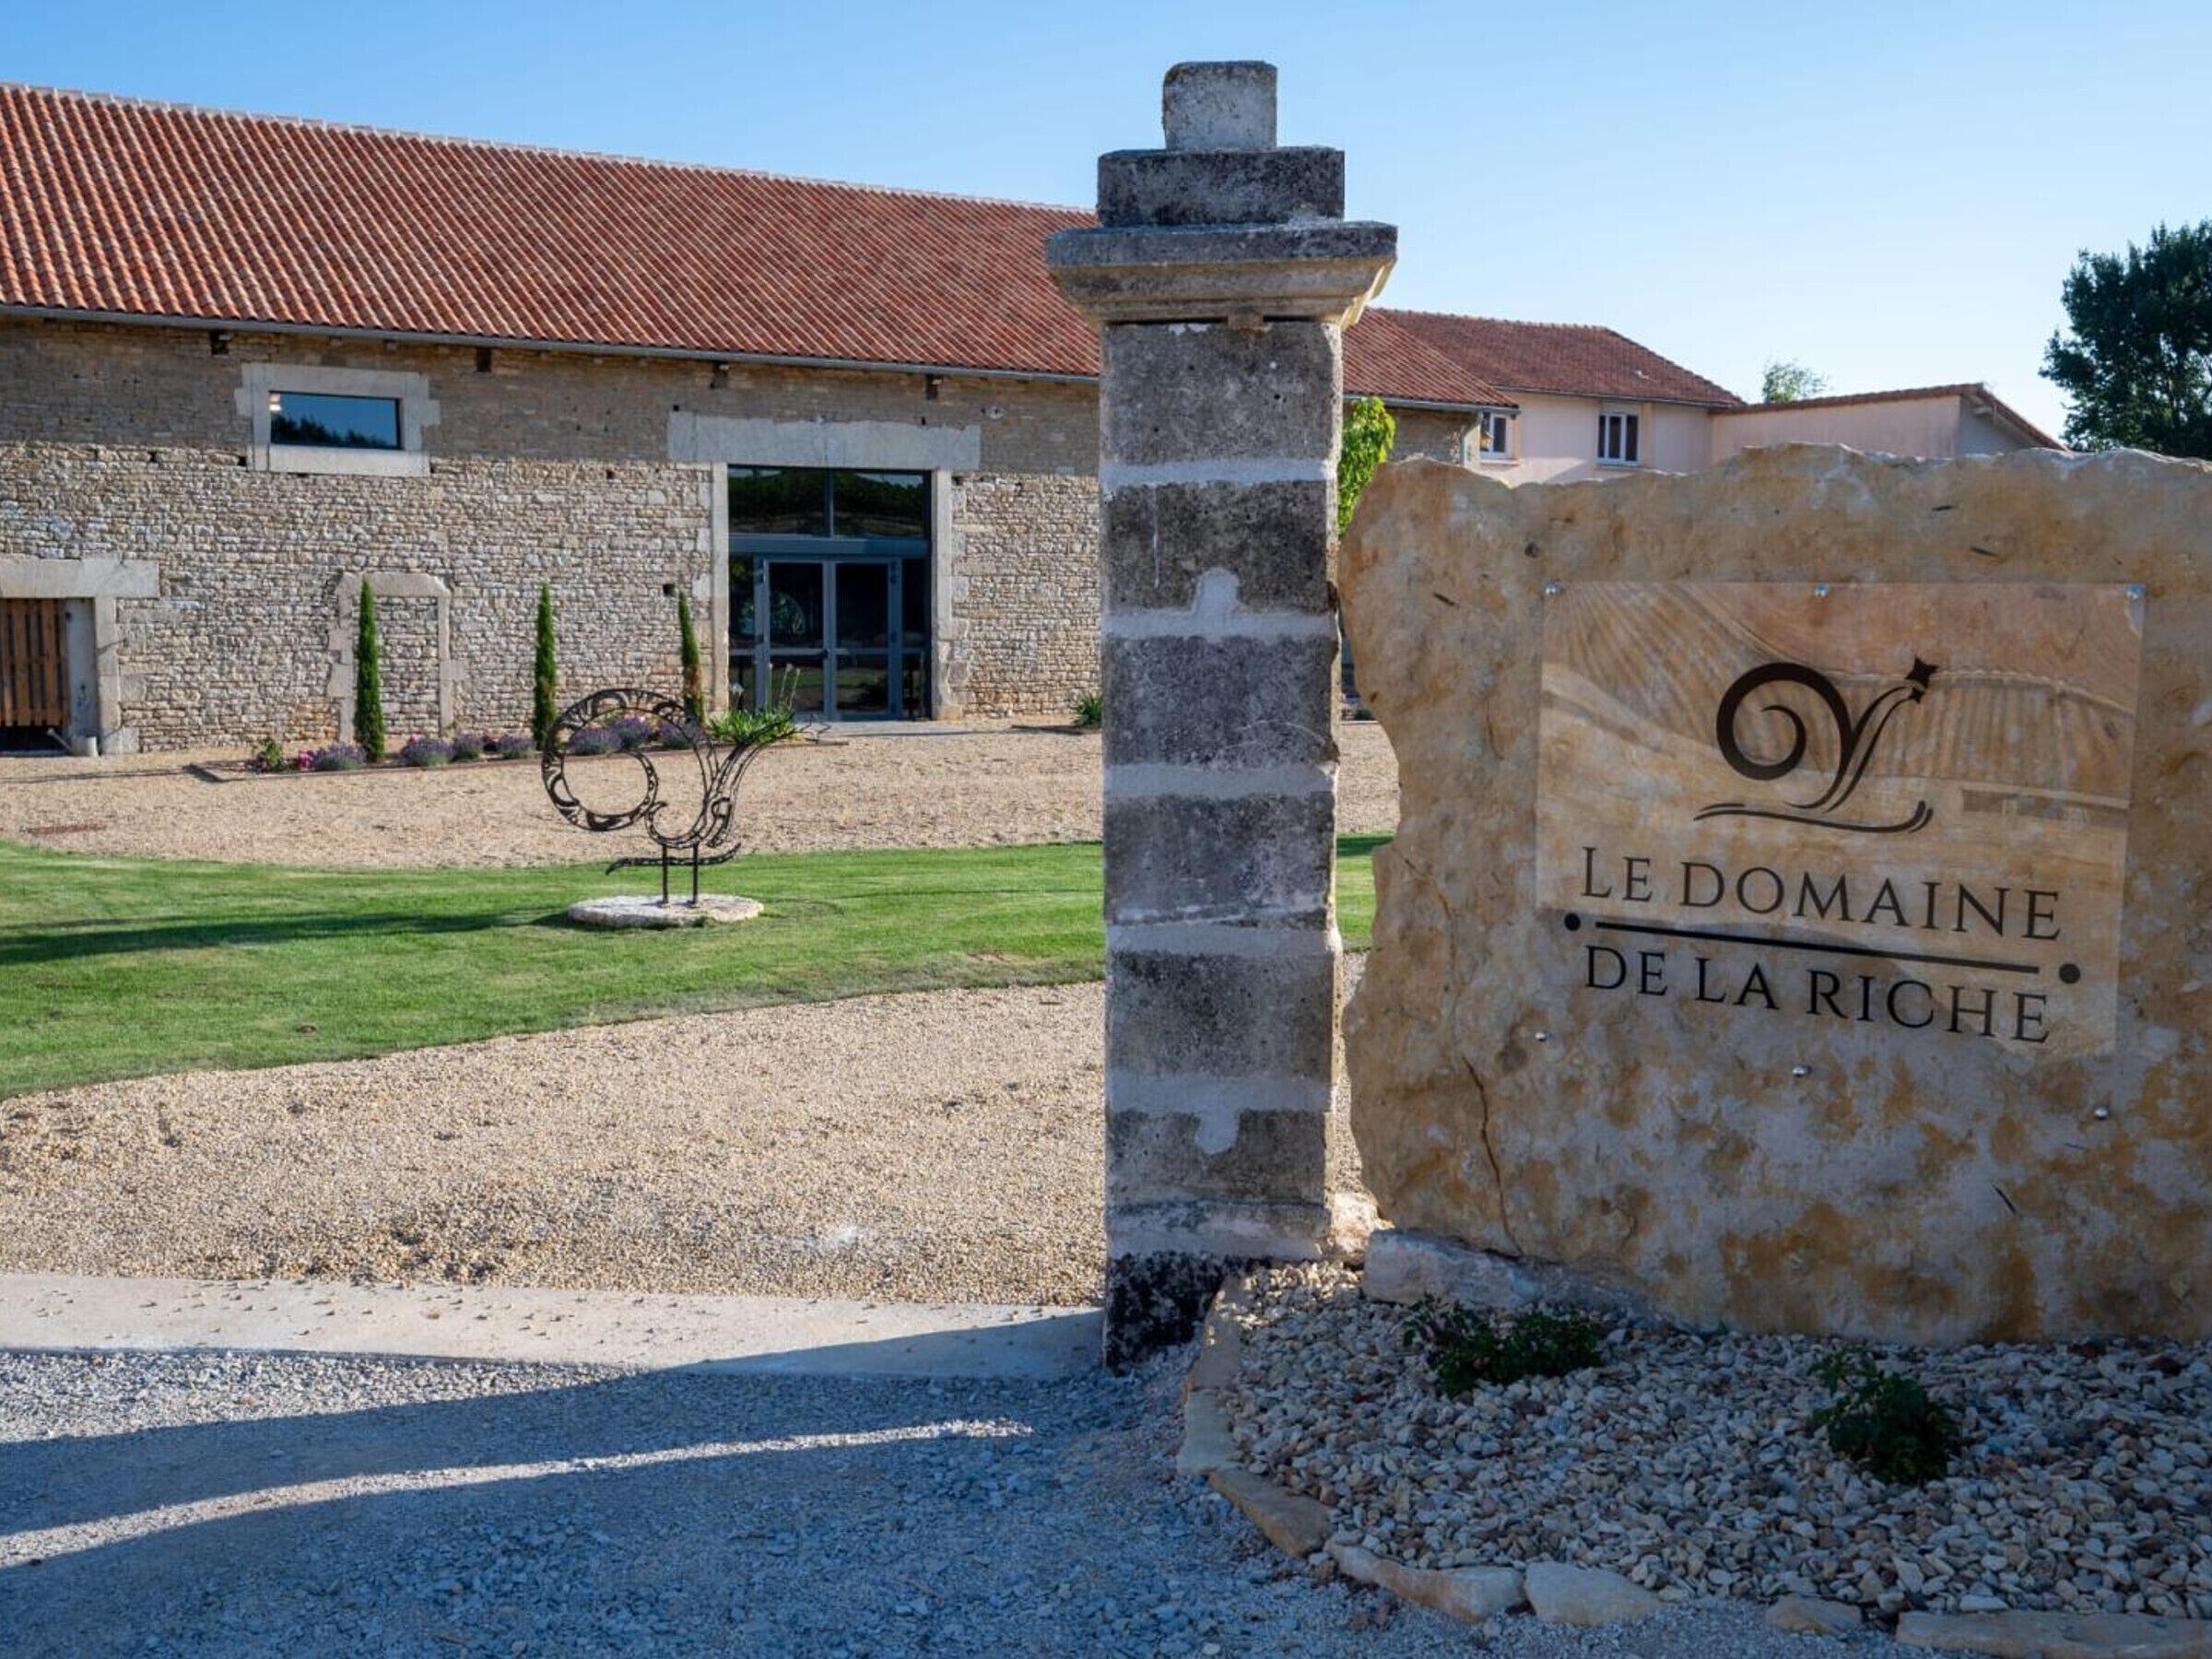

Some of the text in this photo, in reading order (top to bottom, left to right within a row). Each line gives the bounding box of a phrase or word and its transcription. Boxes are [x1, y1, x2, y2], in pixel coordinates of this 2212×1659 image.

[1582, 847, 2061, 940] LE DOMAINE
[1584, 946, 2050, 1043] DE LA RICHE
